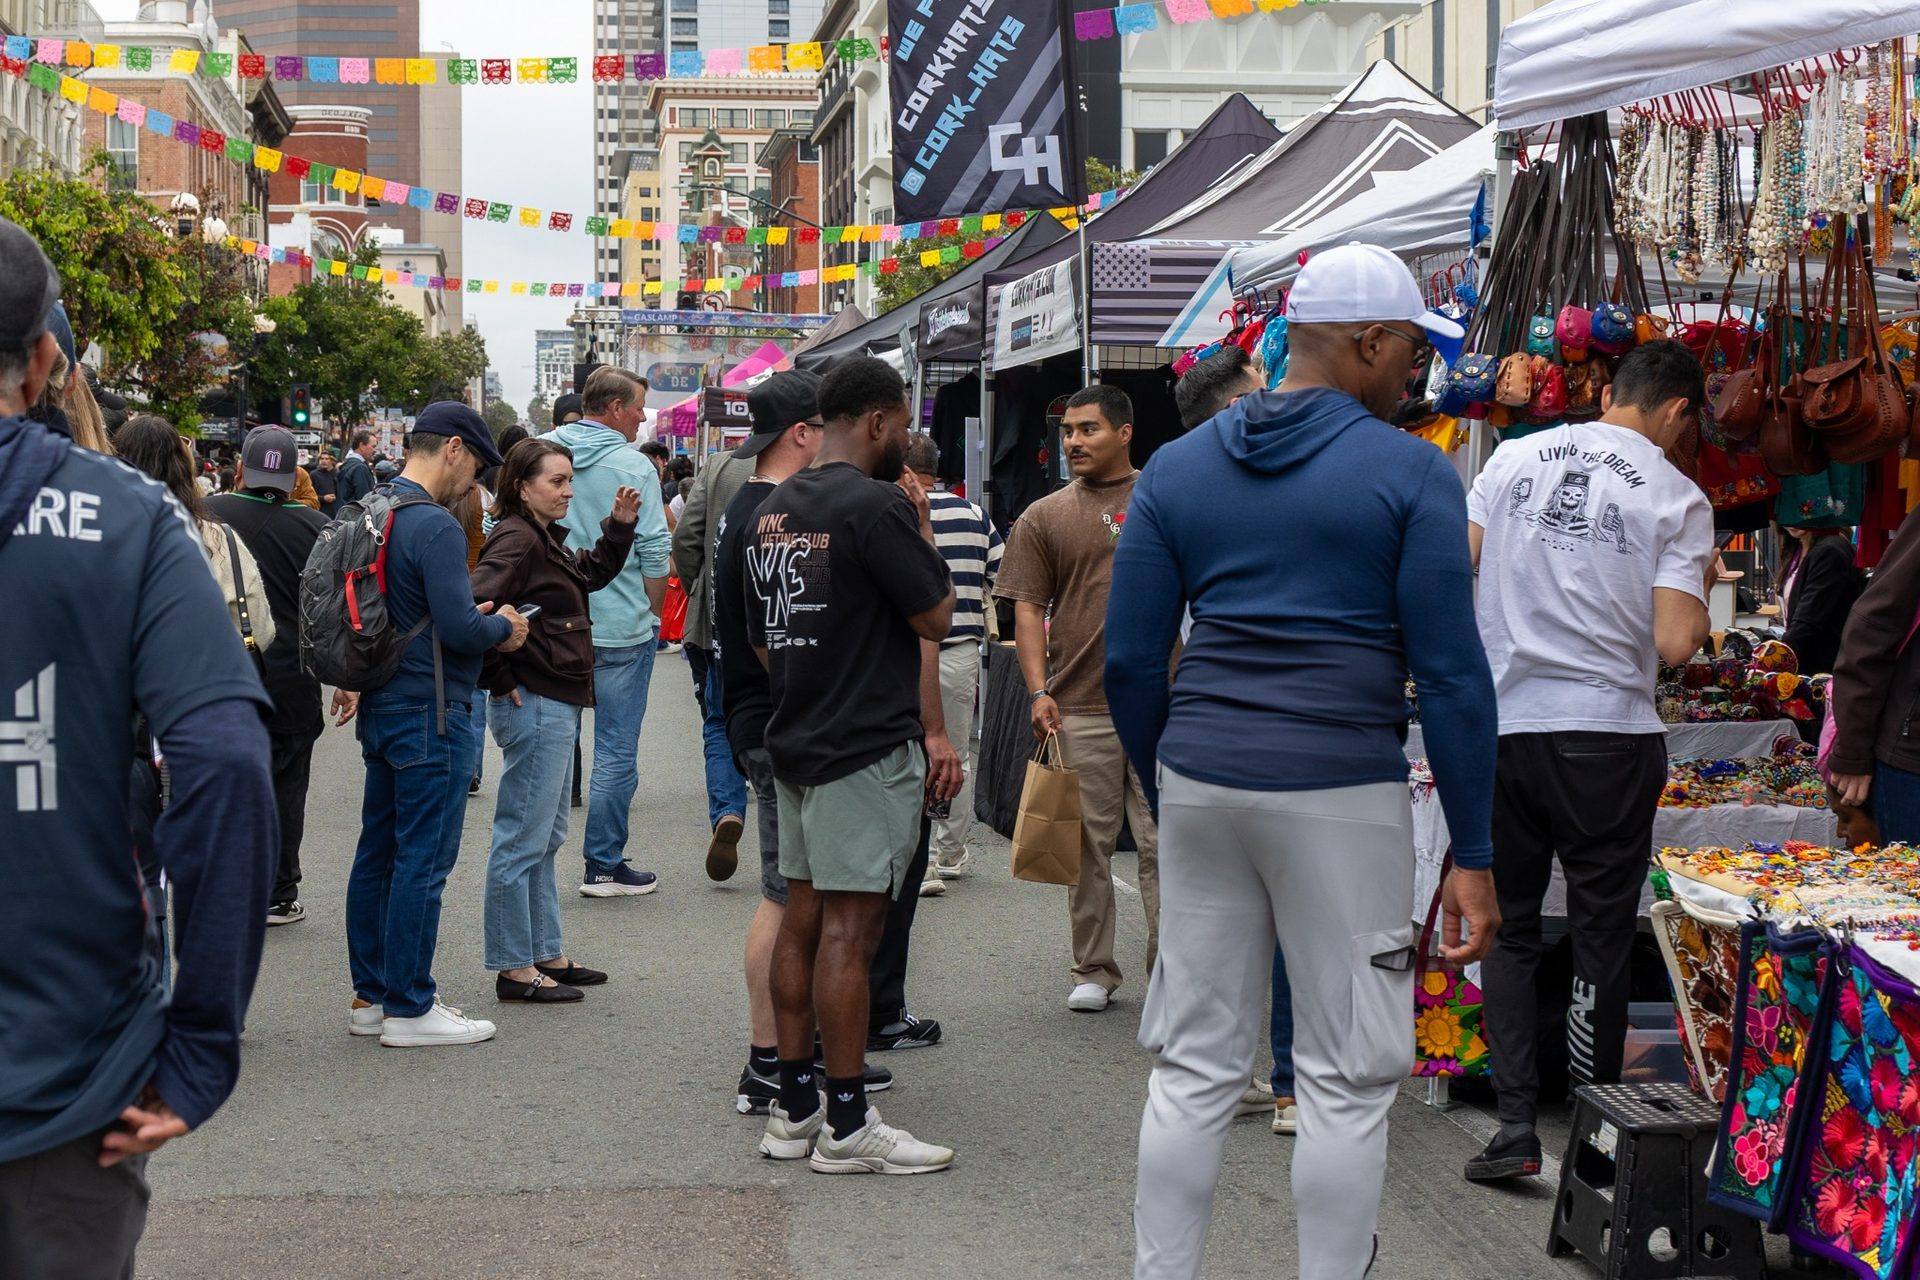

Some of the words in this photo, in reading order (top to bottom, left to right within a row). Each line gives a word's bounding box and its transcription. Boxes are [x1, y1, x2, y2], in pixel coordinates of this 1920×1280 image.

[895, 19, 926, 62] WE
[633, 313, 678, 322] GASLAMP
[1583, 451, 1607, 464] THE
[1603, 453, 1646, 489] DREAM
[12, 486, 103, 542] RE
[757, 513, 789, 534] WNC
[760, 533, 797, 549] LIFTING
[800, 533, 830, 549] CLUB
[595, 875, 614, 883] HOKA
